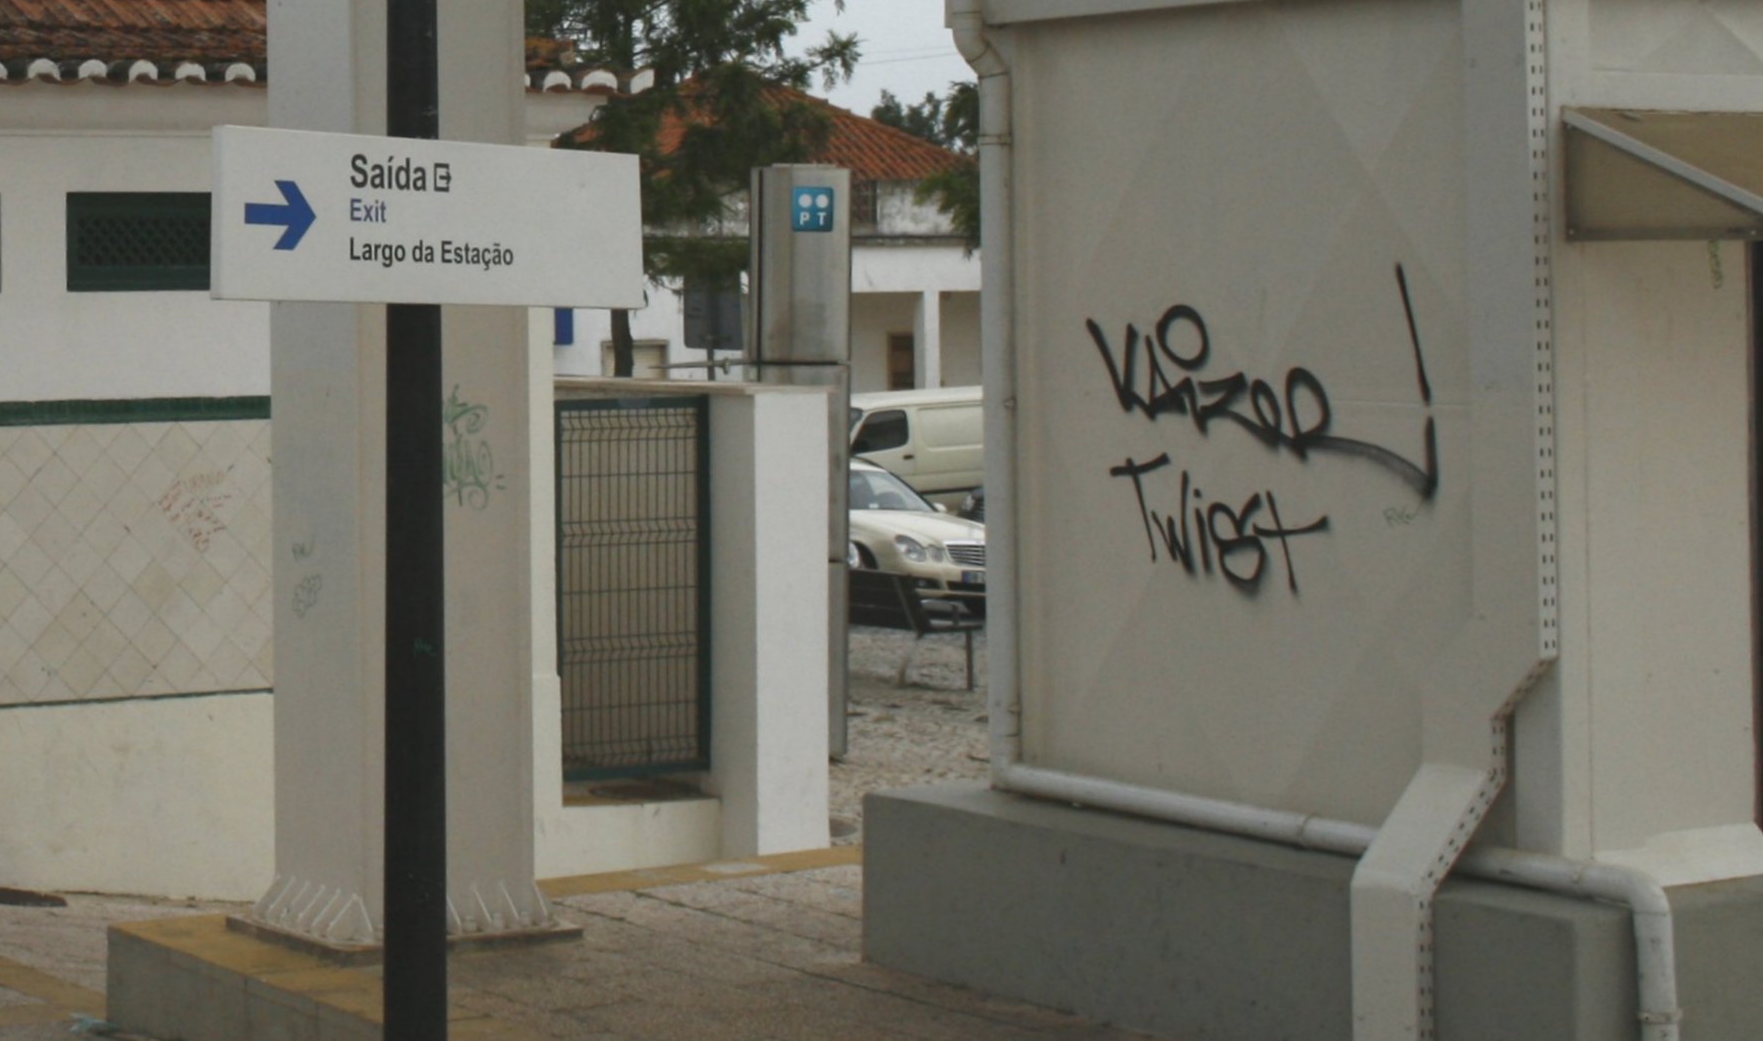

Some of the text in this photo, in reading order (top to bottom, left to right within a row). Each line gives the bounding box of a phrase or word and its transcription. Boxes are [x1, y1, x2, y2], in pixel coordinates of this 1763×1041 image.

[350, 153, 427, 192] Saída
[350, 198, 387, 223] Exit
[349, 236, 514, 271] Largo da Estação
